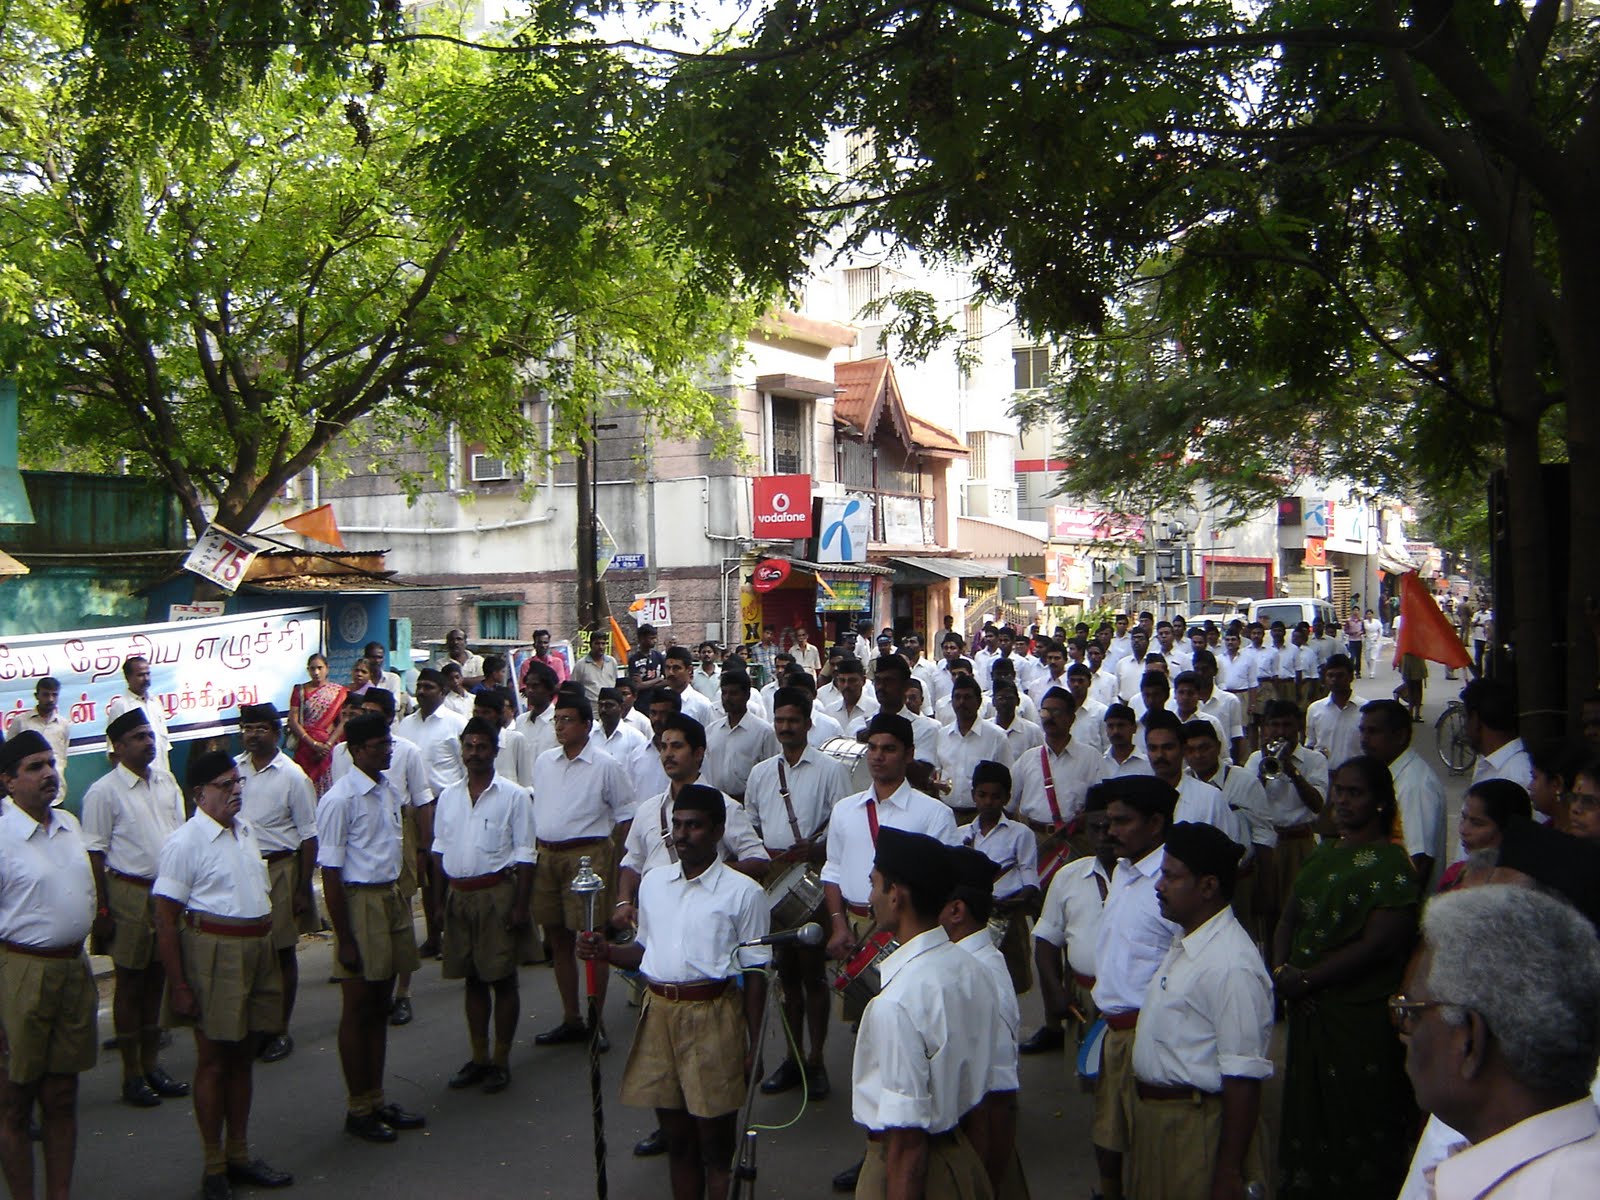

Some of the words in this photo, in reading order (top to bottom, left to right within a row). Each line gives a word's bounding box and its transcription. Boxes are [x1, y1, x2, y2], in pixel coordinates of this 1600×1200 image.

[758, 511, 806, 523] vodafone
[212, 540, 250, 581] 75
[649, 597, 667, 620] 75
